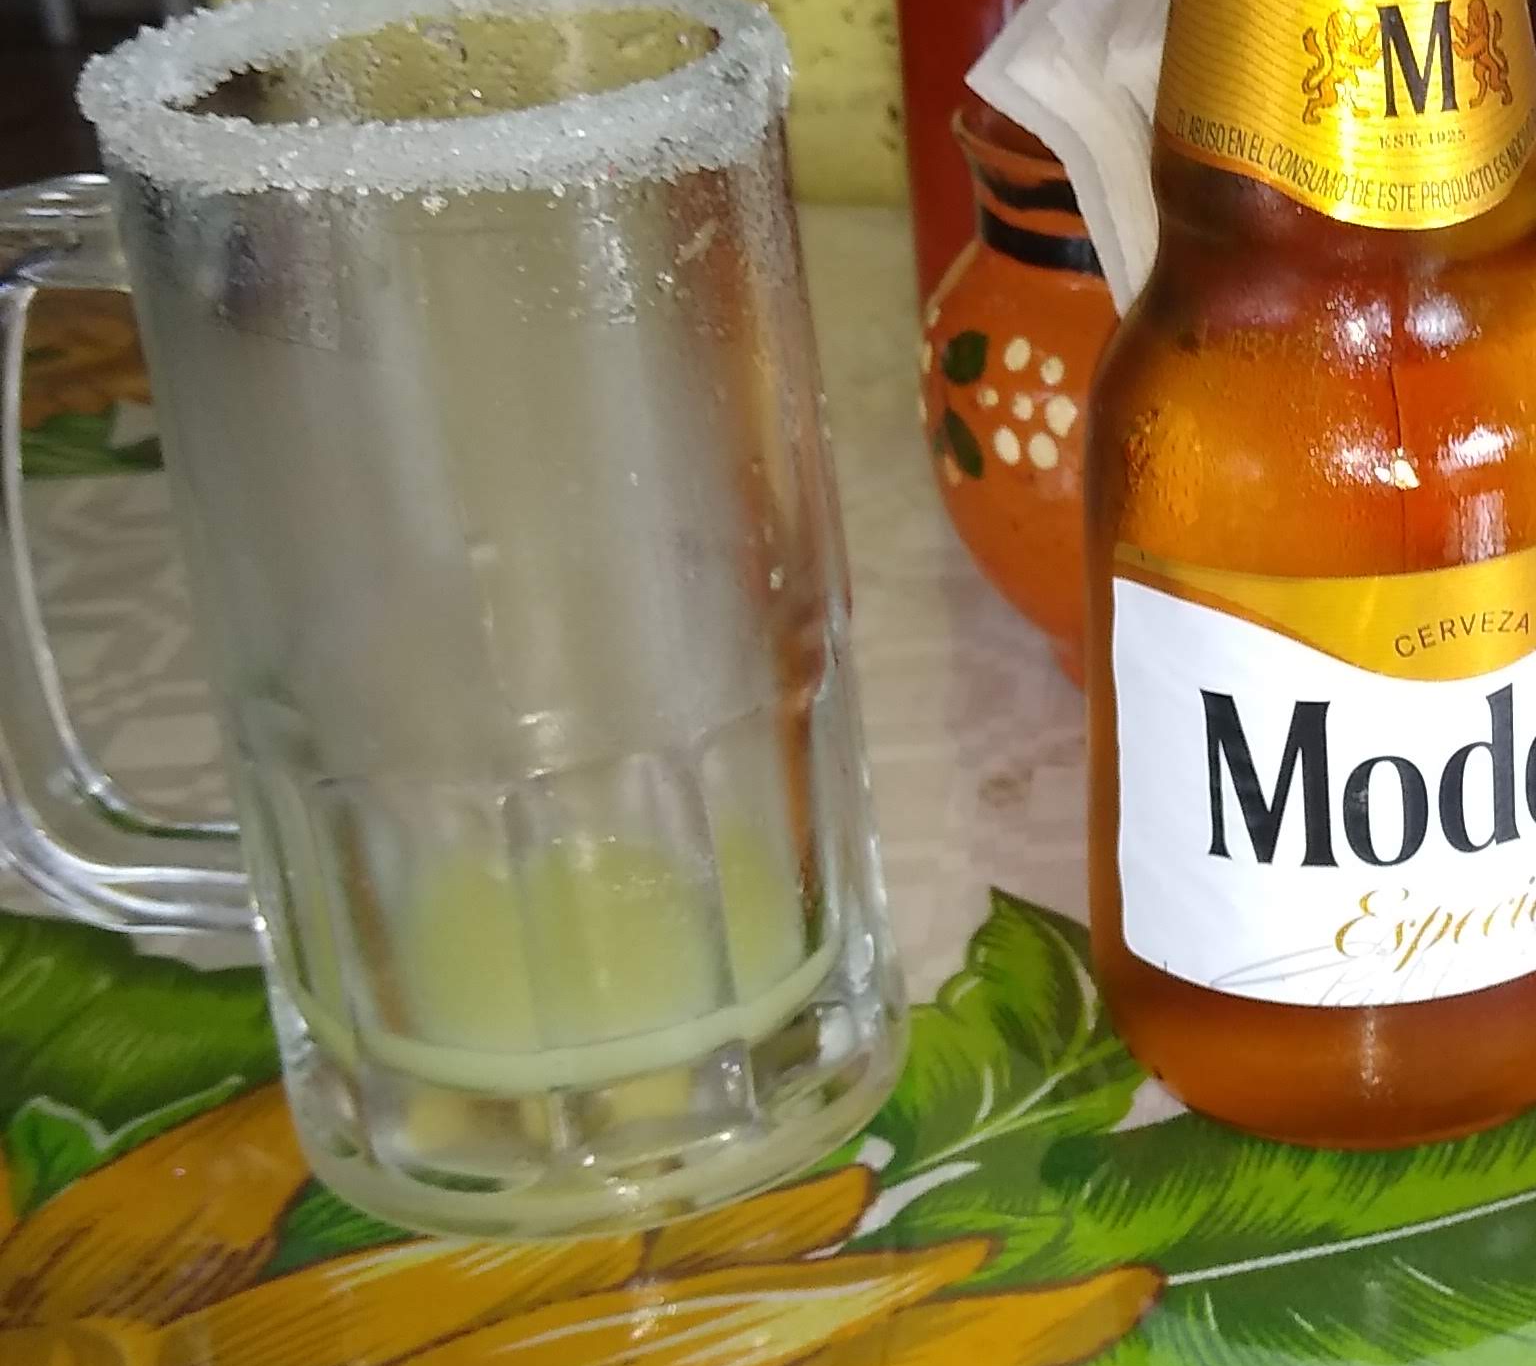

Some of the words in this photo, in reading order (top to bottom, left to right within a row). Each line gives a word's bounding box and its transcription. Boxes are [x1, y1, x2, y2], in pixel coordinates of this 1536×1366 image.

[1378, 0, 1459, 118] M
[1227, 127, 1247, 157] EN
[1249, 135, 1265, 166] EL
[1268, 142, 1349, 201] CONSUMO
[1351, 175, 1376, 210] DE
[1377, 183, 1417, 213] ESTE
[1420, 164, 1497, 210] PRODUCTO
[1393, 609, 1530, 658] CERVEZA
